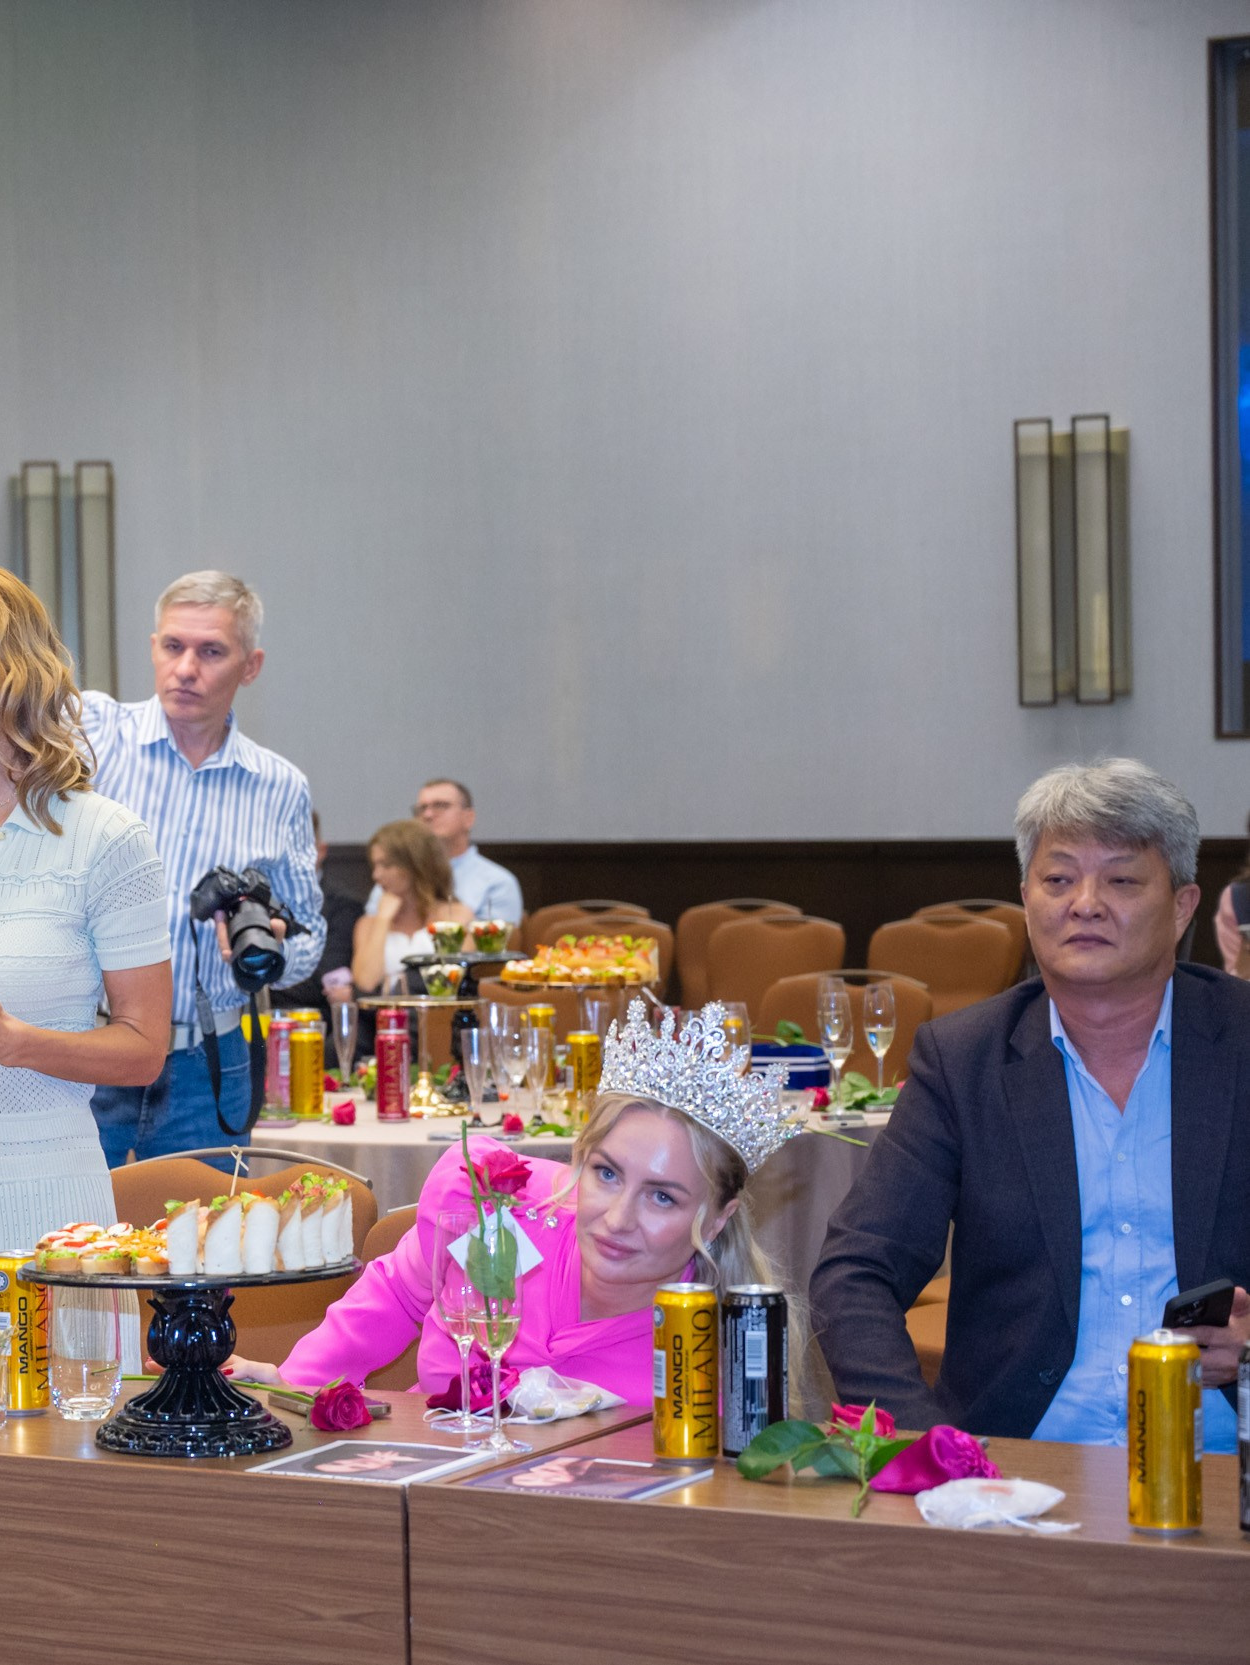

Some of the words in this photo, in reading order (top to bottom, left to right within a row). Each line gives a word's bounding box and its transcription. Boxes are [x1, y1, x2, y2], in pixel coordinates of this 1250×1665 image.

[18, 1296, 28, 1374] MANGO
[673, 1335, 683, 1419] MANGO
[691, 1309, 714, 1440] MILANO
[1137, 1389, 1147, 1484] MANGO
